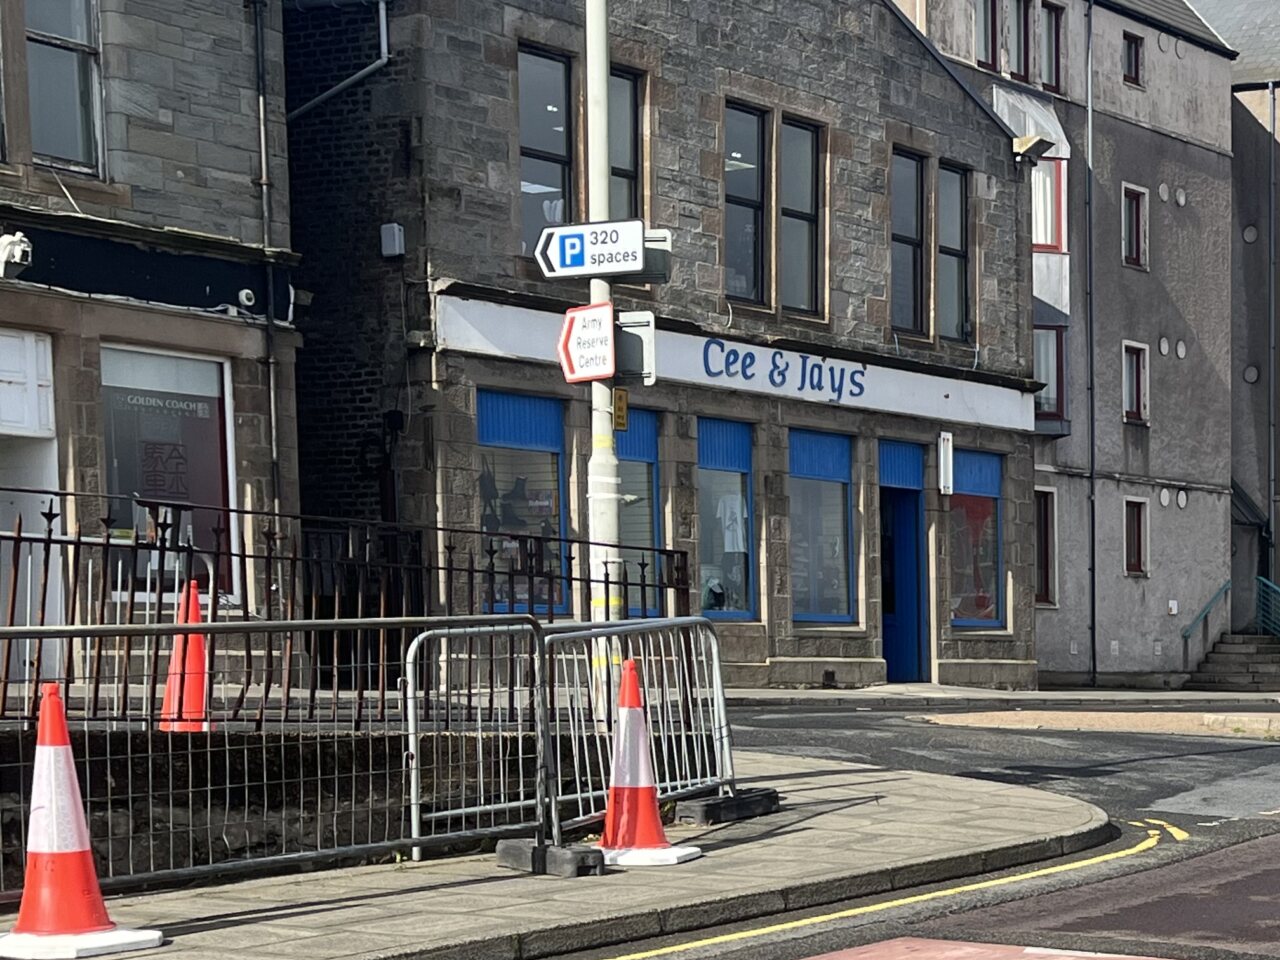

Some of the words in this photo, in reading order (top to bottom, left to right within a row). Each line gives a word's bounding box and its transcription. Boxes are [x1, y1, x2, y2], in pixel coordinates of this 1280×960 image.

[590, 229, 619, 245] 320
[565, 237, 581, 266] P
[590, 250, 638, 266] spaces
[581, 317, 603, 331] Army
[576, 335, 609, 350] Reserve
[579, 353, 608, 368] Centre
[703, 338, 756, 381] Cee
[768, 350, 790, 388] &
[127, 395, 164, 408] GOLDEN
[165, 399, 197, 412] COACH
